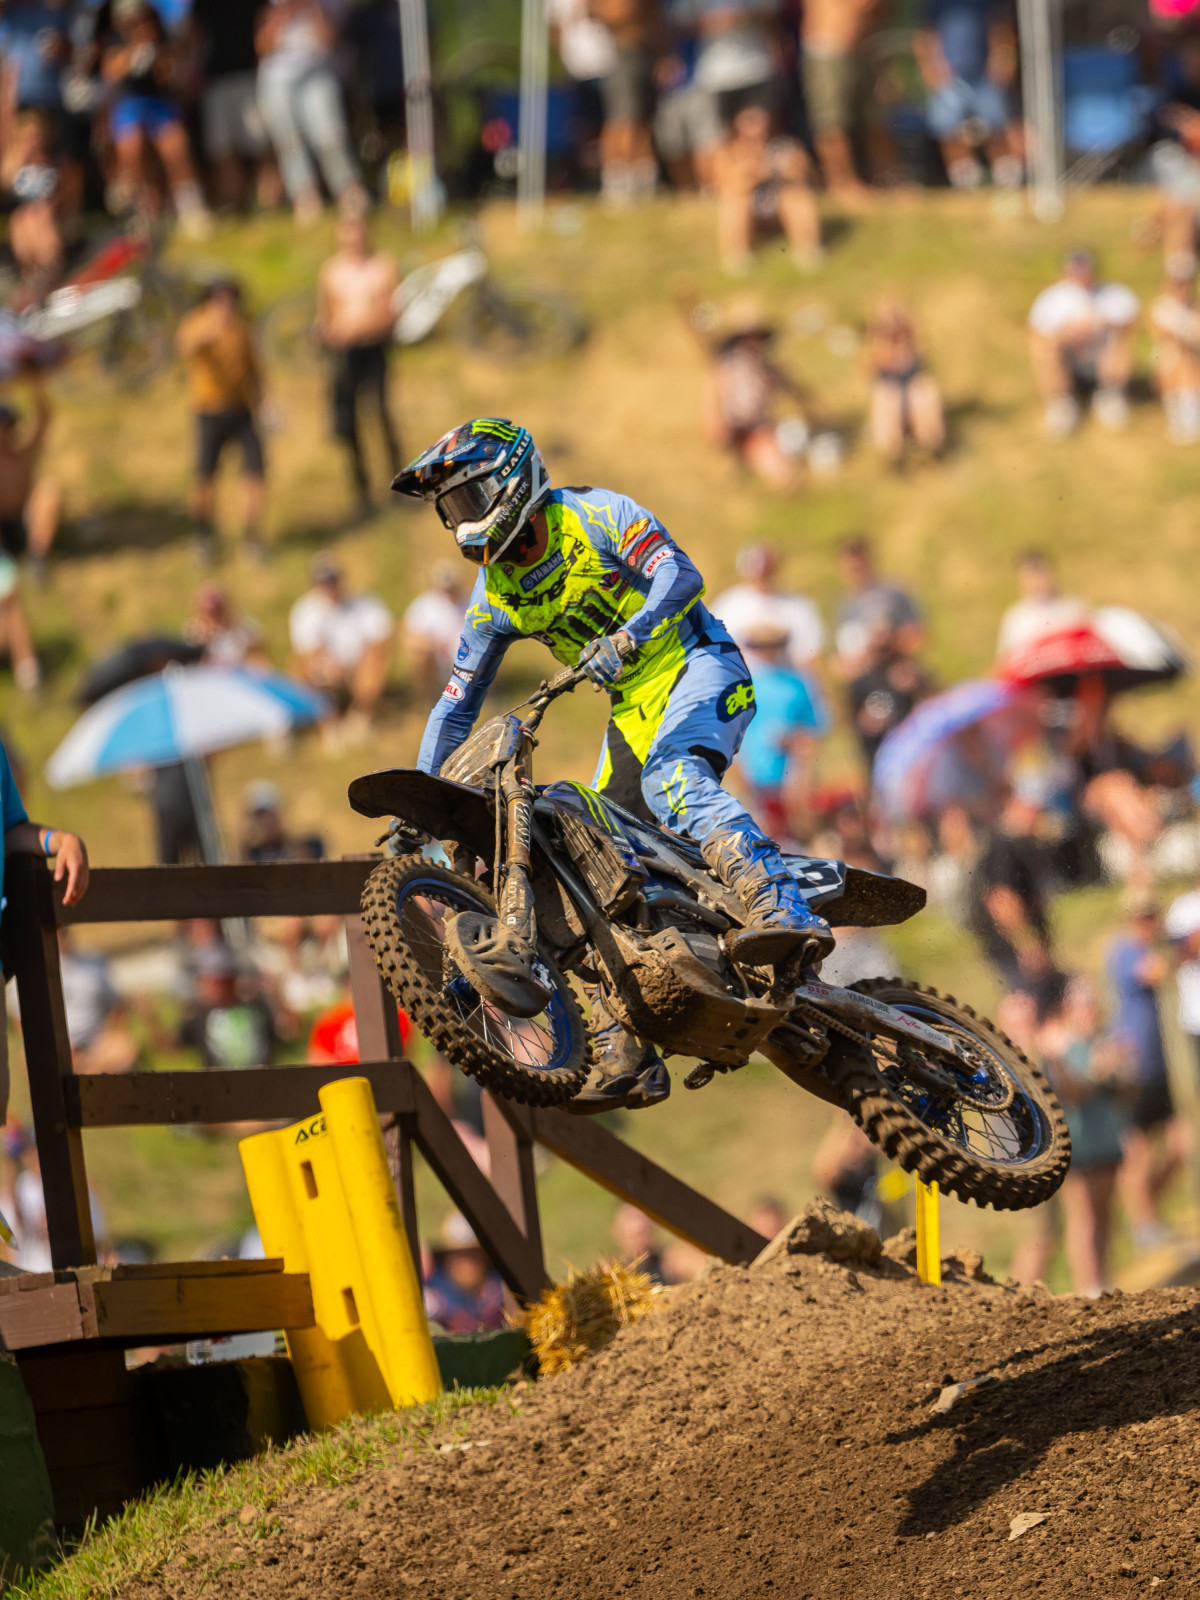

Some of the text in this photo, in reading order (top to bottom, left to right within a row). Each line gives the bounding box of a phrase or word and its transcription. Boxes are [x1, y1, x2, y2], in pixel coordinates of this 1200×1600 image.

[497, 481, 529, 524] MONSTER
[529, 551, 564, 582] YAMAHA
[646, 550, 668, 573] BELL
[847, 991, 891, 1014] YAMALUBE
